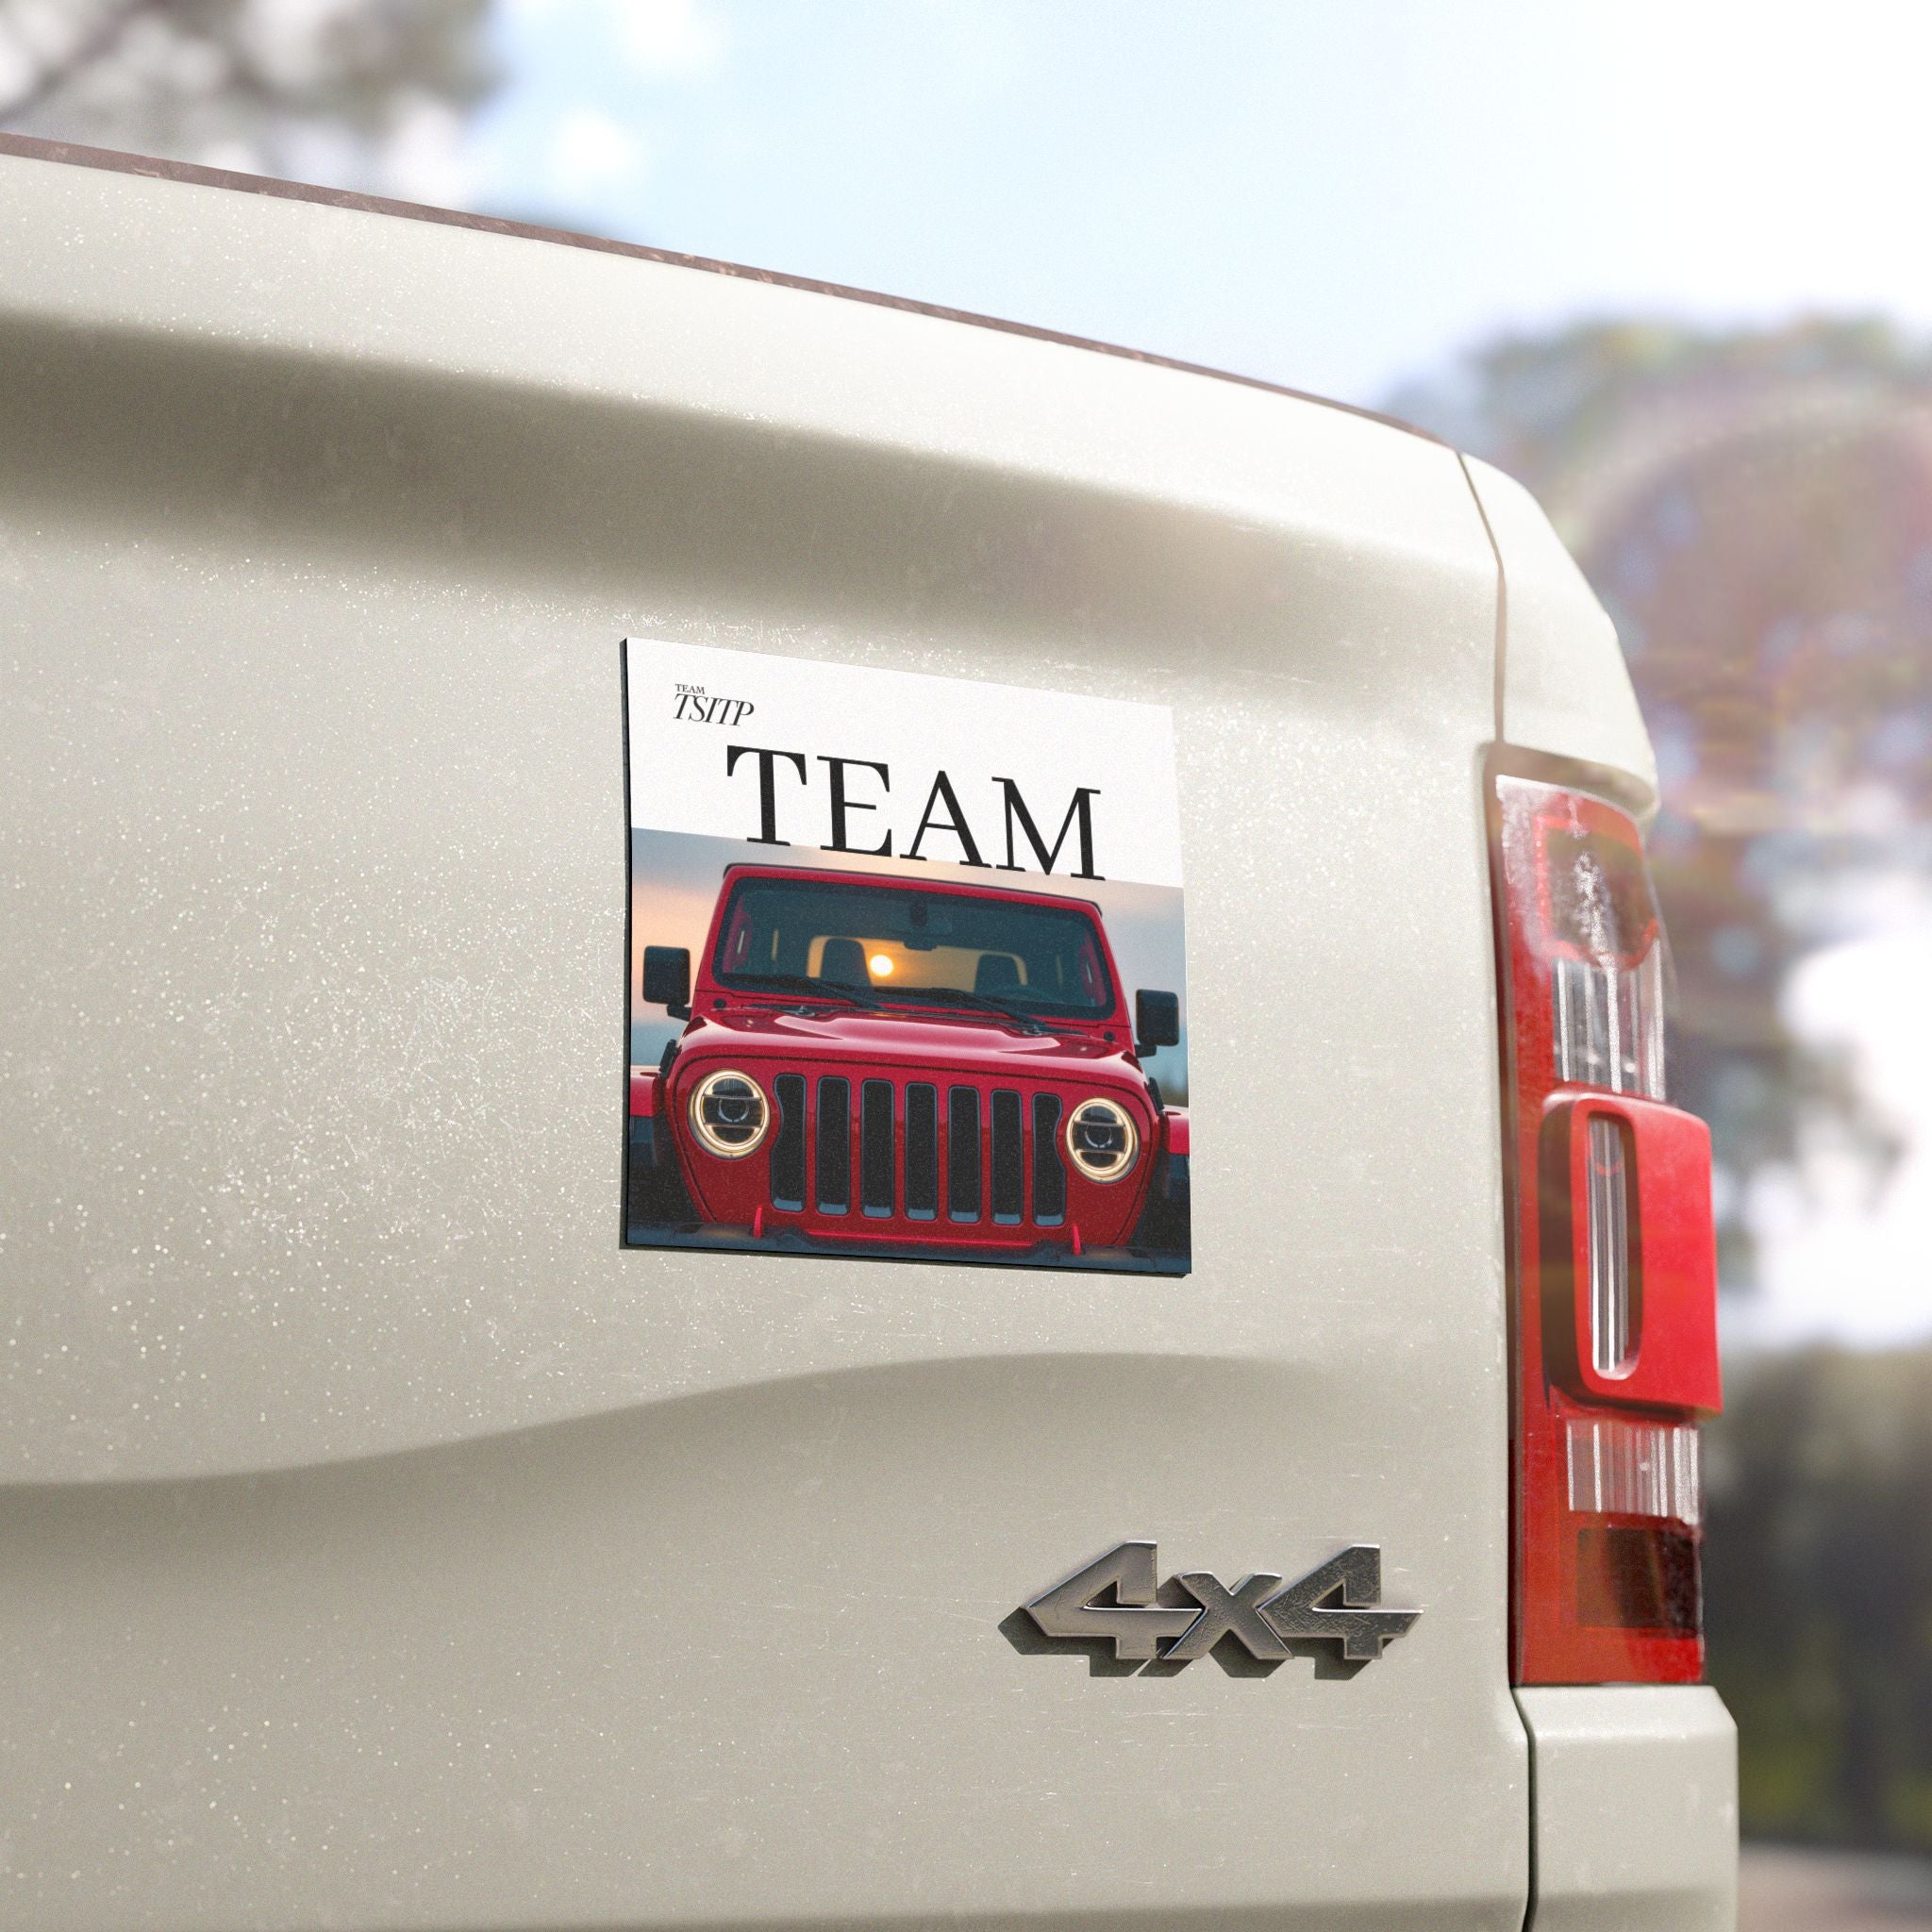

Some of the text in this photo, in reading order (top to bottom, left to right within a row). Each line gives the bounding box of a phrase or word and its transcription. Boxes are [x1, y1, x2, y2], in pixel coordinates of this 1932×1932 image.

[673, 693, 755, 726] TSITP
[675, 684, 706, 694] TEAM
[727, 745, 1105, 881] TEAM
[1023, 1540, 1424, 1659] 4x4
